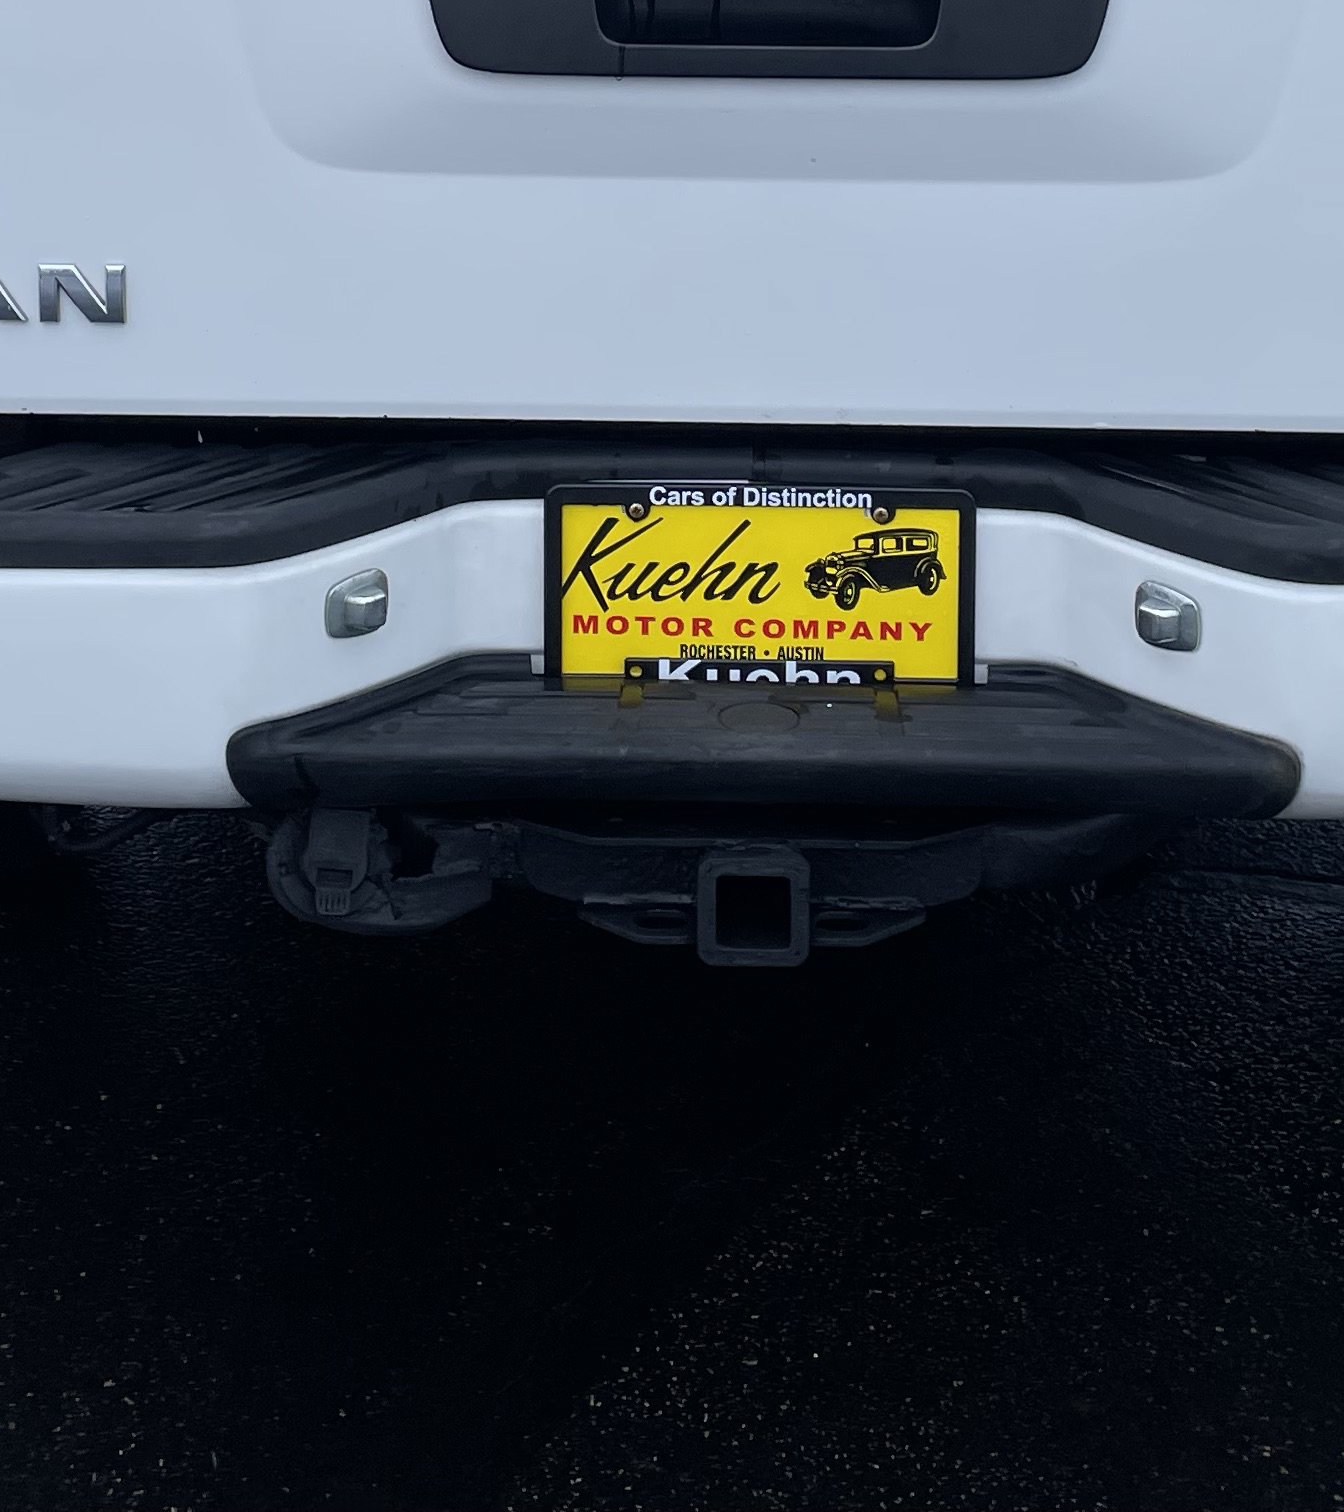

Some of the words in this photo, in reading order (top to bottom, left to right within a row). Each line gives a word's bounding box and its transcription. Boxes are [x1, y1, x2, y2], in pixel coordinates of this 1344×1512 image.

[649, 486, 704, 507] Cars
[712, 486, 737, 507] of
[743, 488, 872, 509] Distinction
[561, 516, 781, 613] Kuehn
[572, 615, 713, 637] MOTOR
[734, 618, 933, 642] COMPANY
[680, 643, 756, 661] ROCHESTER
[777, 645, 825, 662] AUSTIN
